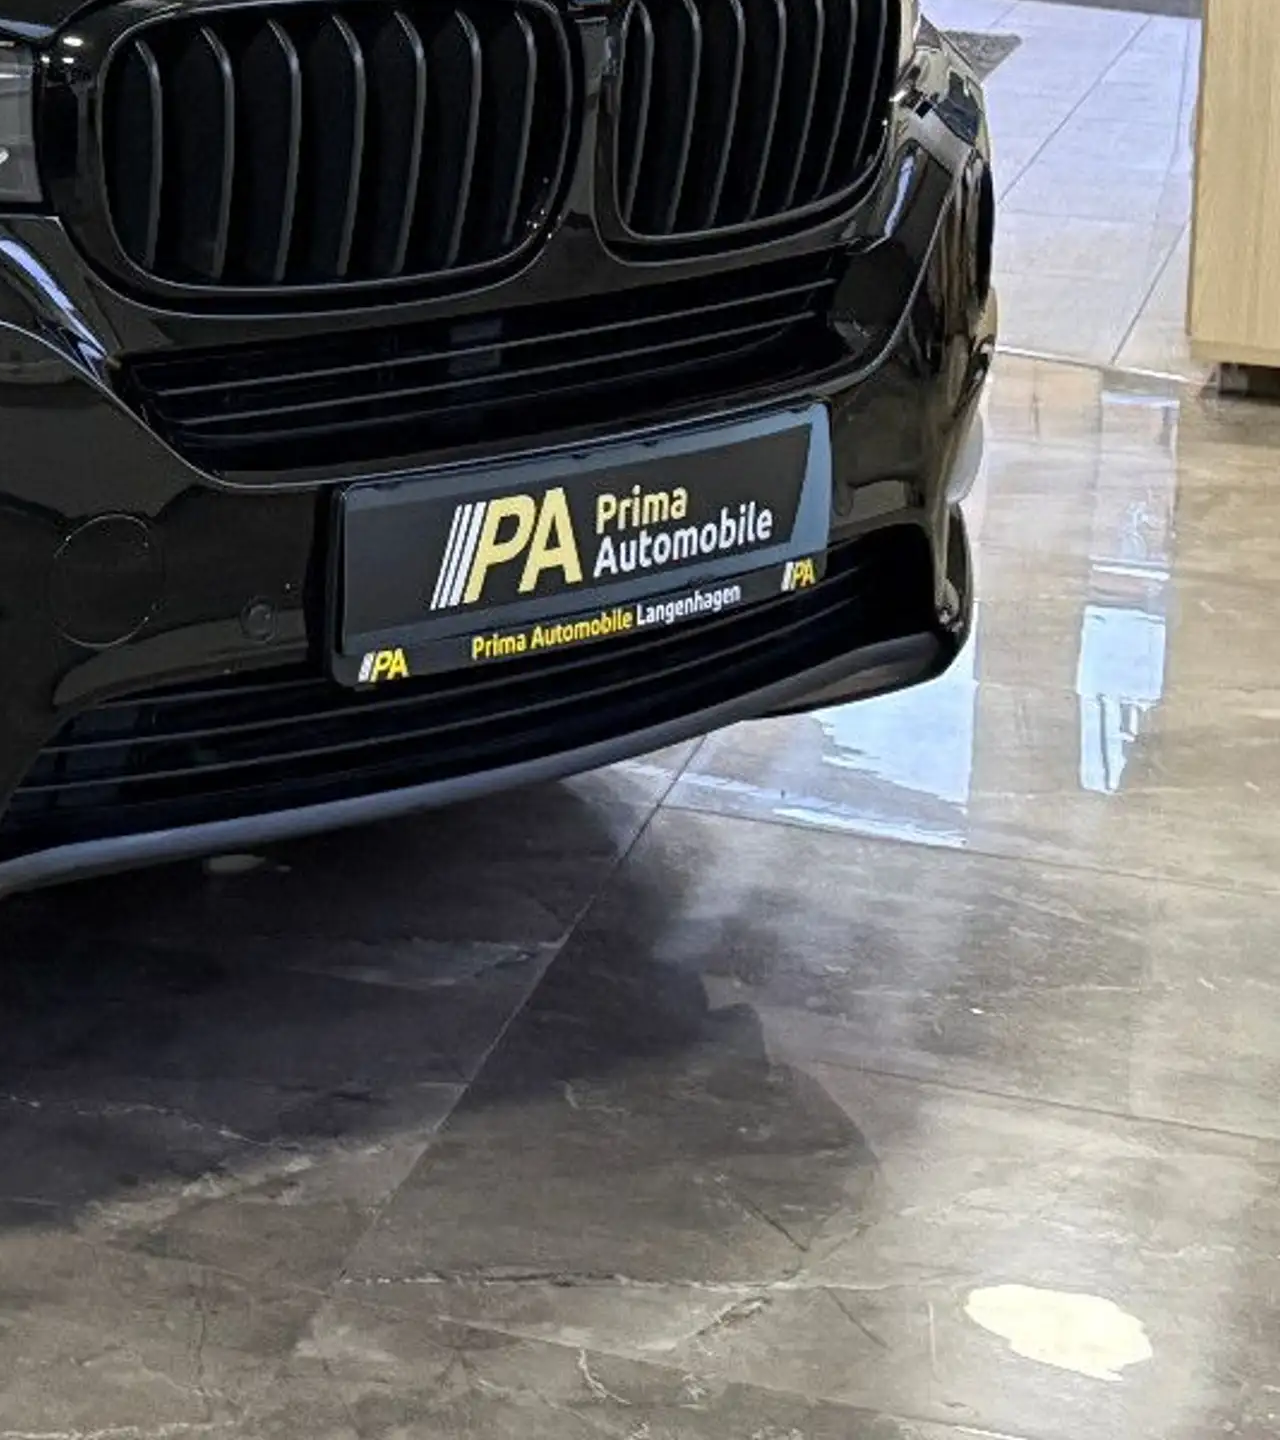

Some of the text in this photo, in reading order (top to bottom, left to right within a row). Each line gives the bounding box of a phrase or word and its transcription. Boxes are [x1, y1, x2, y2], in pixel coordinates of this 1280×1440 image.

[593, 500, 774, 578] Automobile
[596, 485, 689, 535] Prima
[471, 583, 742, 660] Prima Automobile Langenhagen
